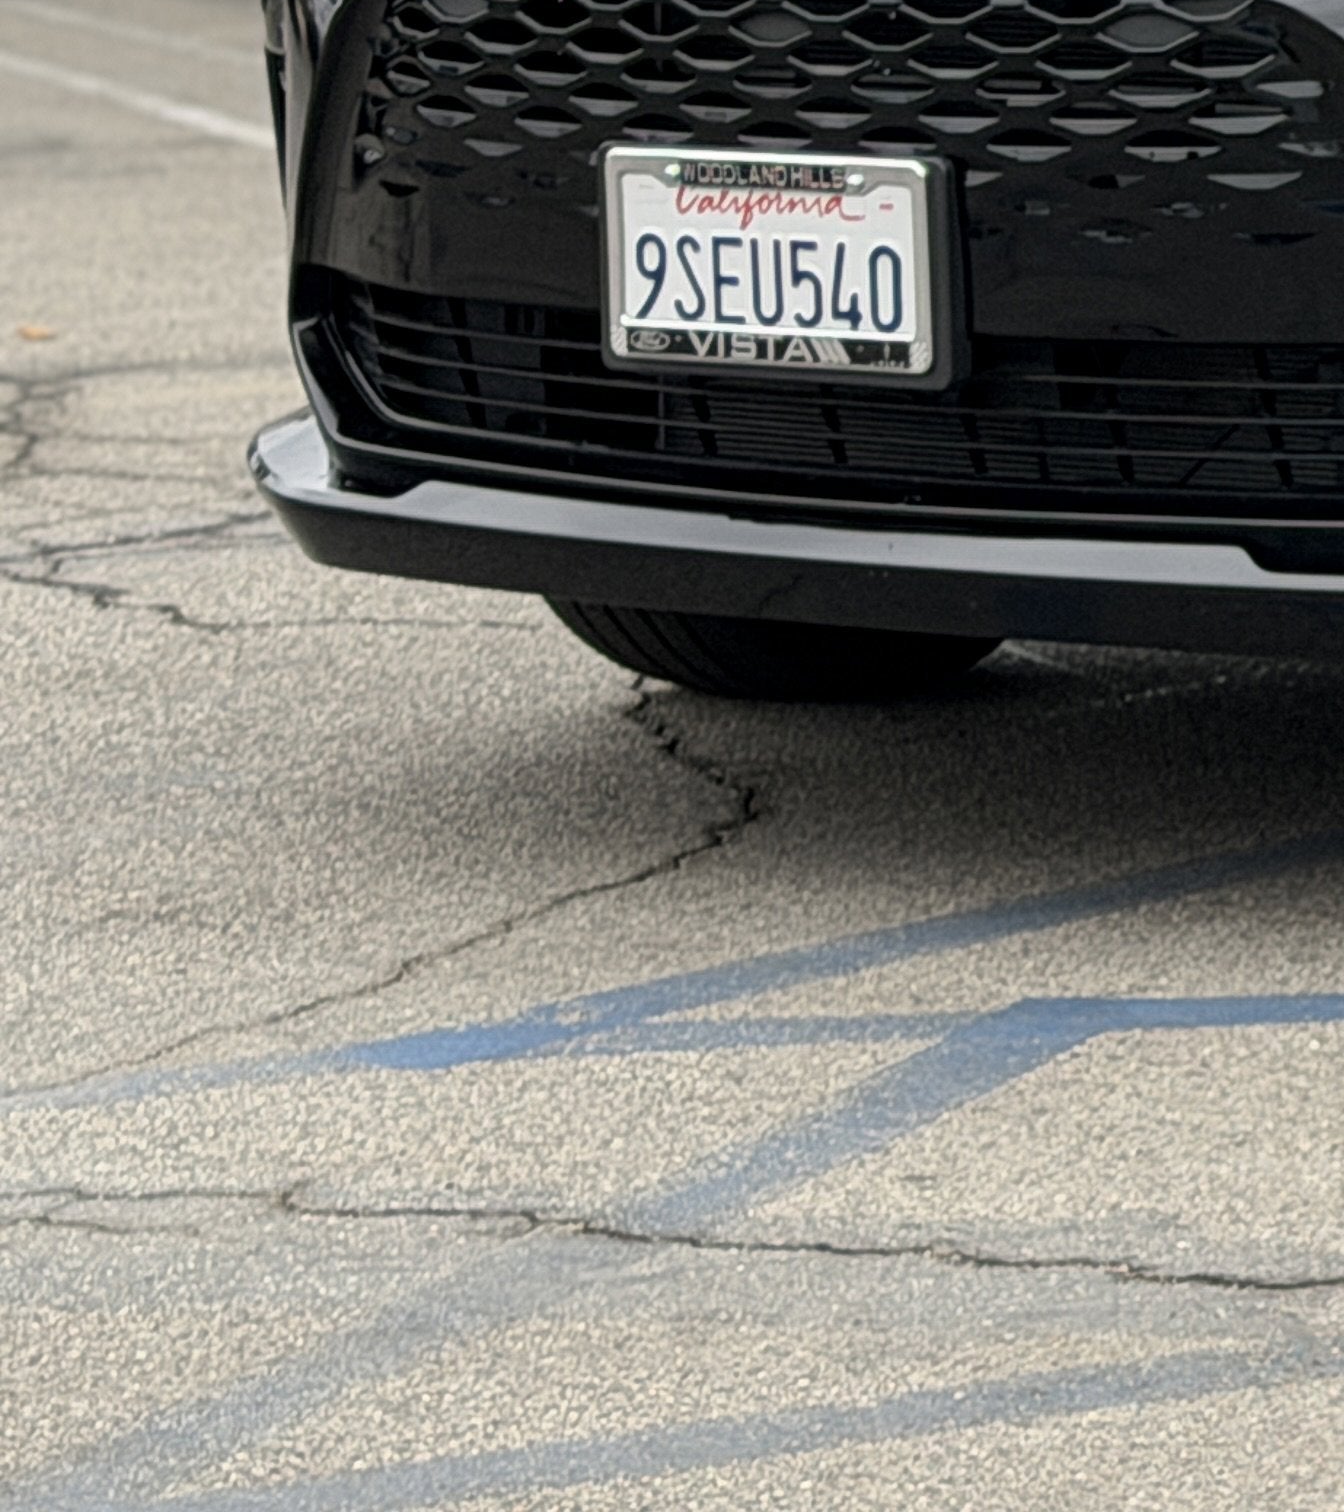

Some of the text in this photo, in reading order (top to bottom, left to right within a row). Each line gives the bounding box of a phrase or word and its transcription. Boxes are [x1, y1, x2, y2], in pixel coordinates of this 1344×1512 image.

[682, 162, 846, 189] WOODLAND HILLS
[675, 185, 866, 231] California
[634, 232, 903, 333] 9SEU540
[689, 331, 815, 364] VISTA
